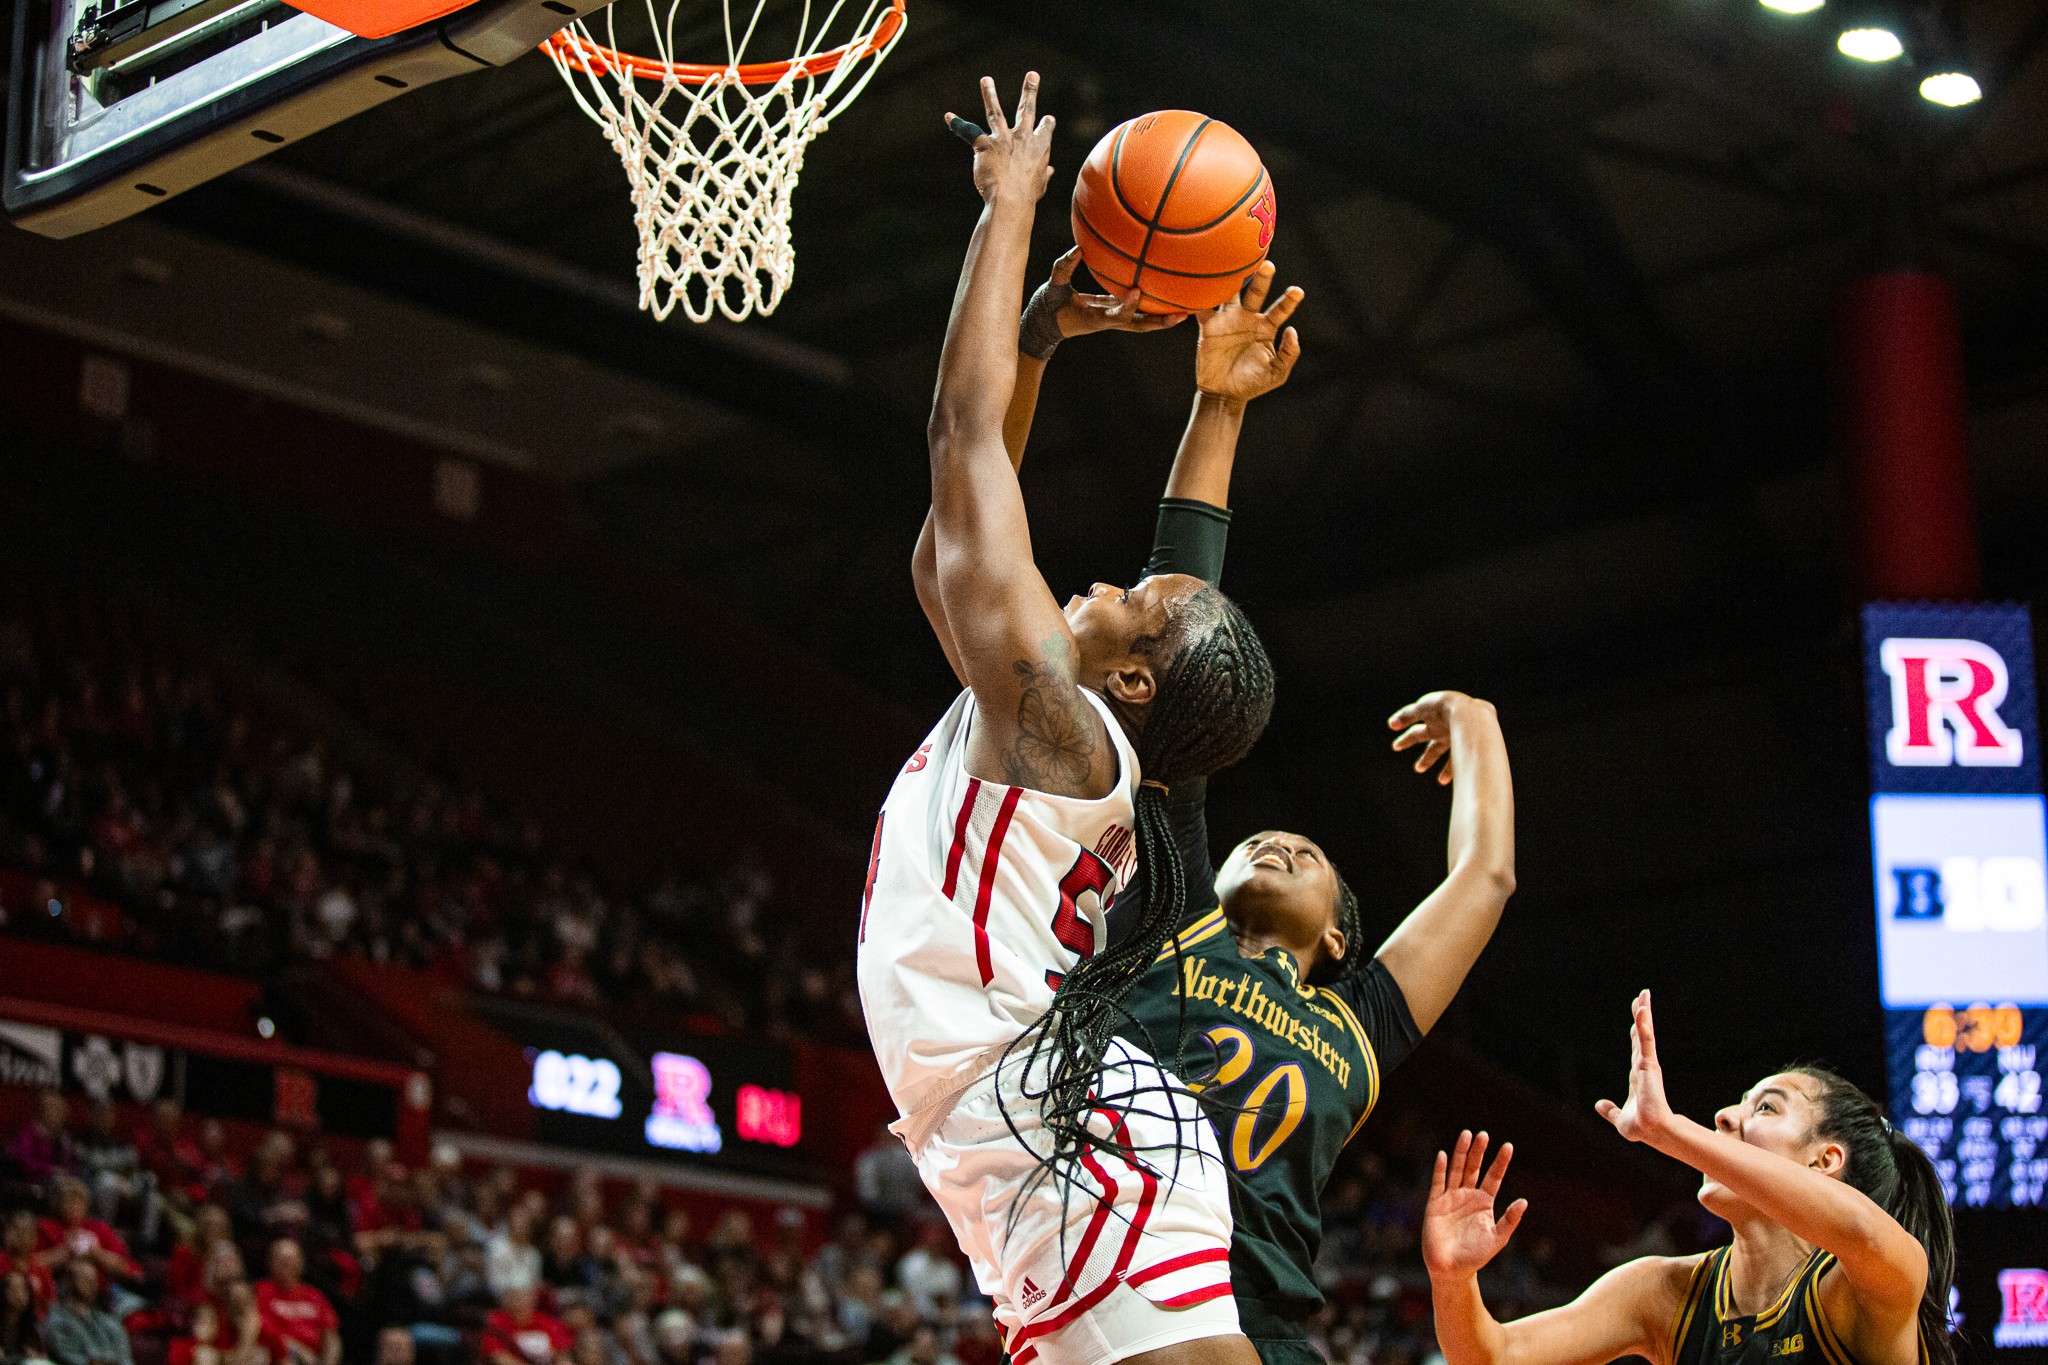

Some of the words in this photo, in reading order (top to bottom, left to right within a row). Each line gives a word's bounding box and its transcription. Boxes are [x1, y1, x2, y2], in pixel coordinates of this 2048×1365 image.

[1881, 638, 2024, 767] R
[1171, 955, 1351, 1090] Northwestern
[1186, 1024, 1309, 1175] 20
[1022, 1288, 1047, 1310] adidas
